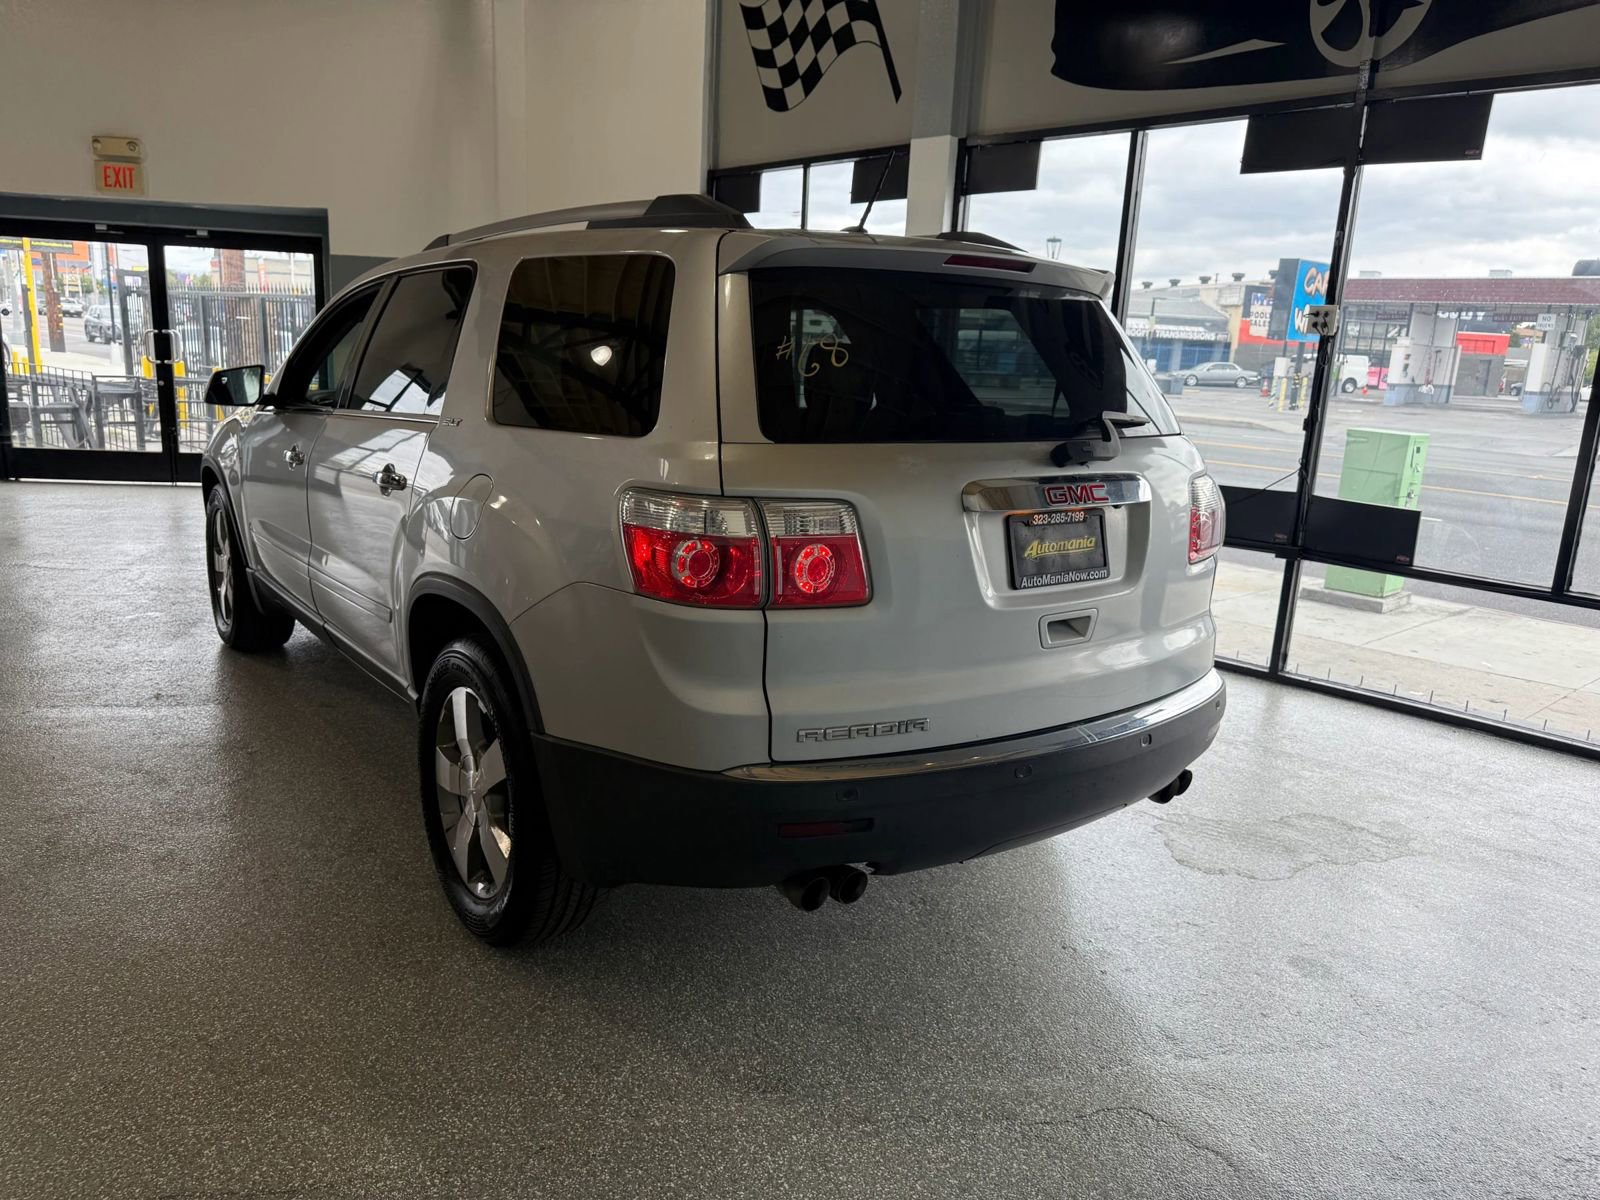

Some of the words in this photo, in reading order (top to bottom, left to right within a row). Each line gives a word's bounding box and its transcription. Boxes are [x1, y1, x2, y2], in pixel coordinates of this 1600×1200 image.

[103, 165, 135, 189] EXIT
[1156, 329, 1216, 341] TRANSMISSIONS
[1044, 484, 1110, 505] GMC
[1032, 511, 1085, 525] 323-285-7199
[1024, 535, 1096, 558] Automania
[1021, 569, 1107, 588] AutoManiaNow.com
[797, 717, 930, 743] ACADIA
